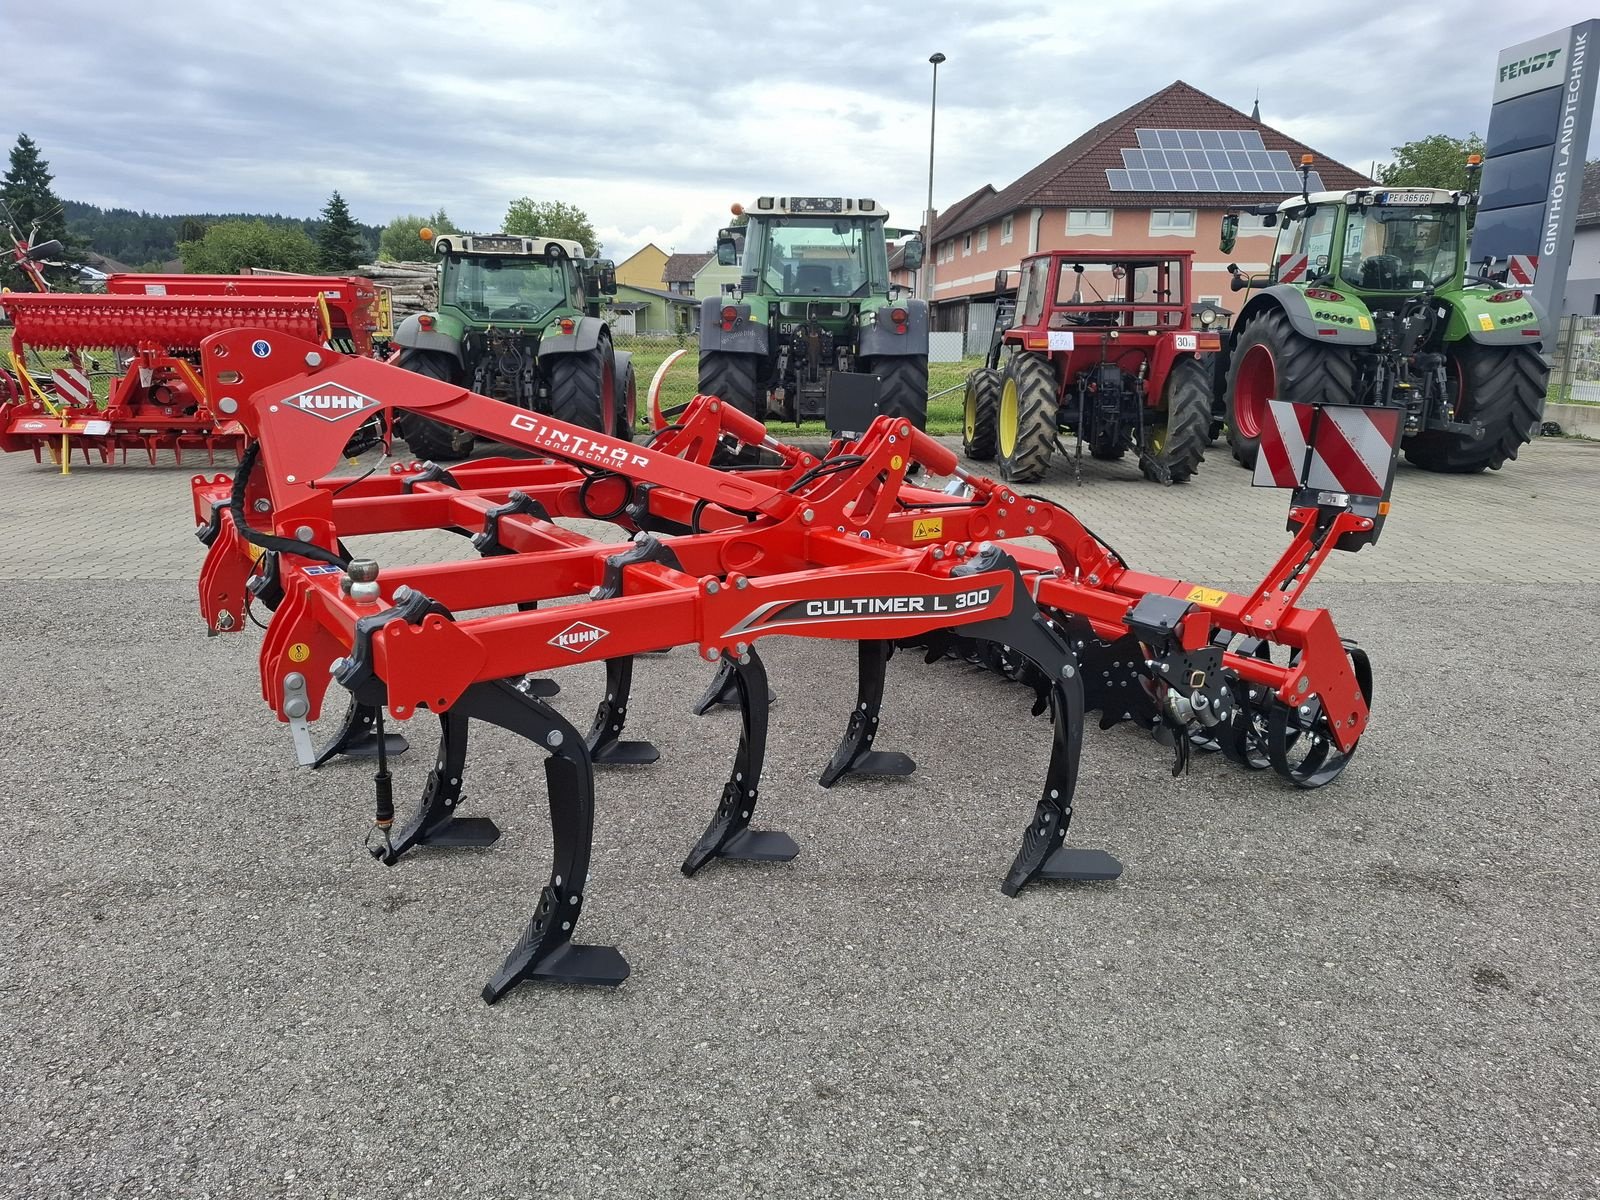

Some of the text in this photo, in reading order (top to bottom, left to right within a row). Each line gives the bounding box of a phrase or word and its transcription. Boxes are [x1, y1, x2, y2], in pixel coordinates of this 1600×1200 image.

[1499, 48, 1562, 83] FENDT
[1544, 31, 1588, 256] GINTHÖR LANDTECHNIK
[781, 323, 792, 334] 50
[1177, 337, 1188, 347] 30
[299, 395, 364, 409] KUHN
[510, 413, 650, 468] GINTHÖR
[806, 589, 990, 616] CULTIMER L 300
[559, 629, 600, 646] KUHN
